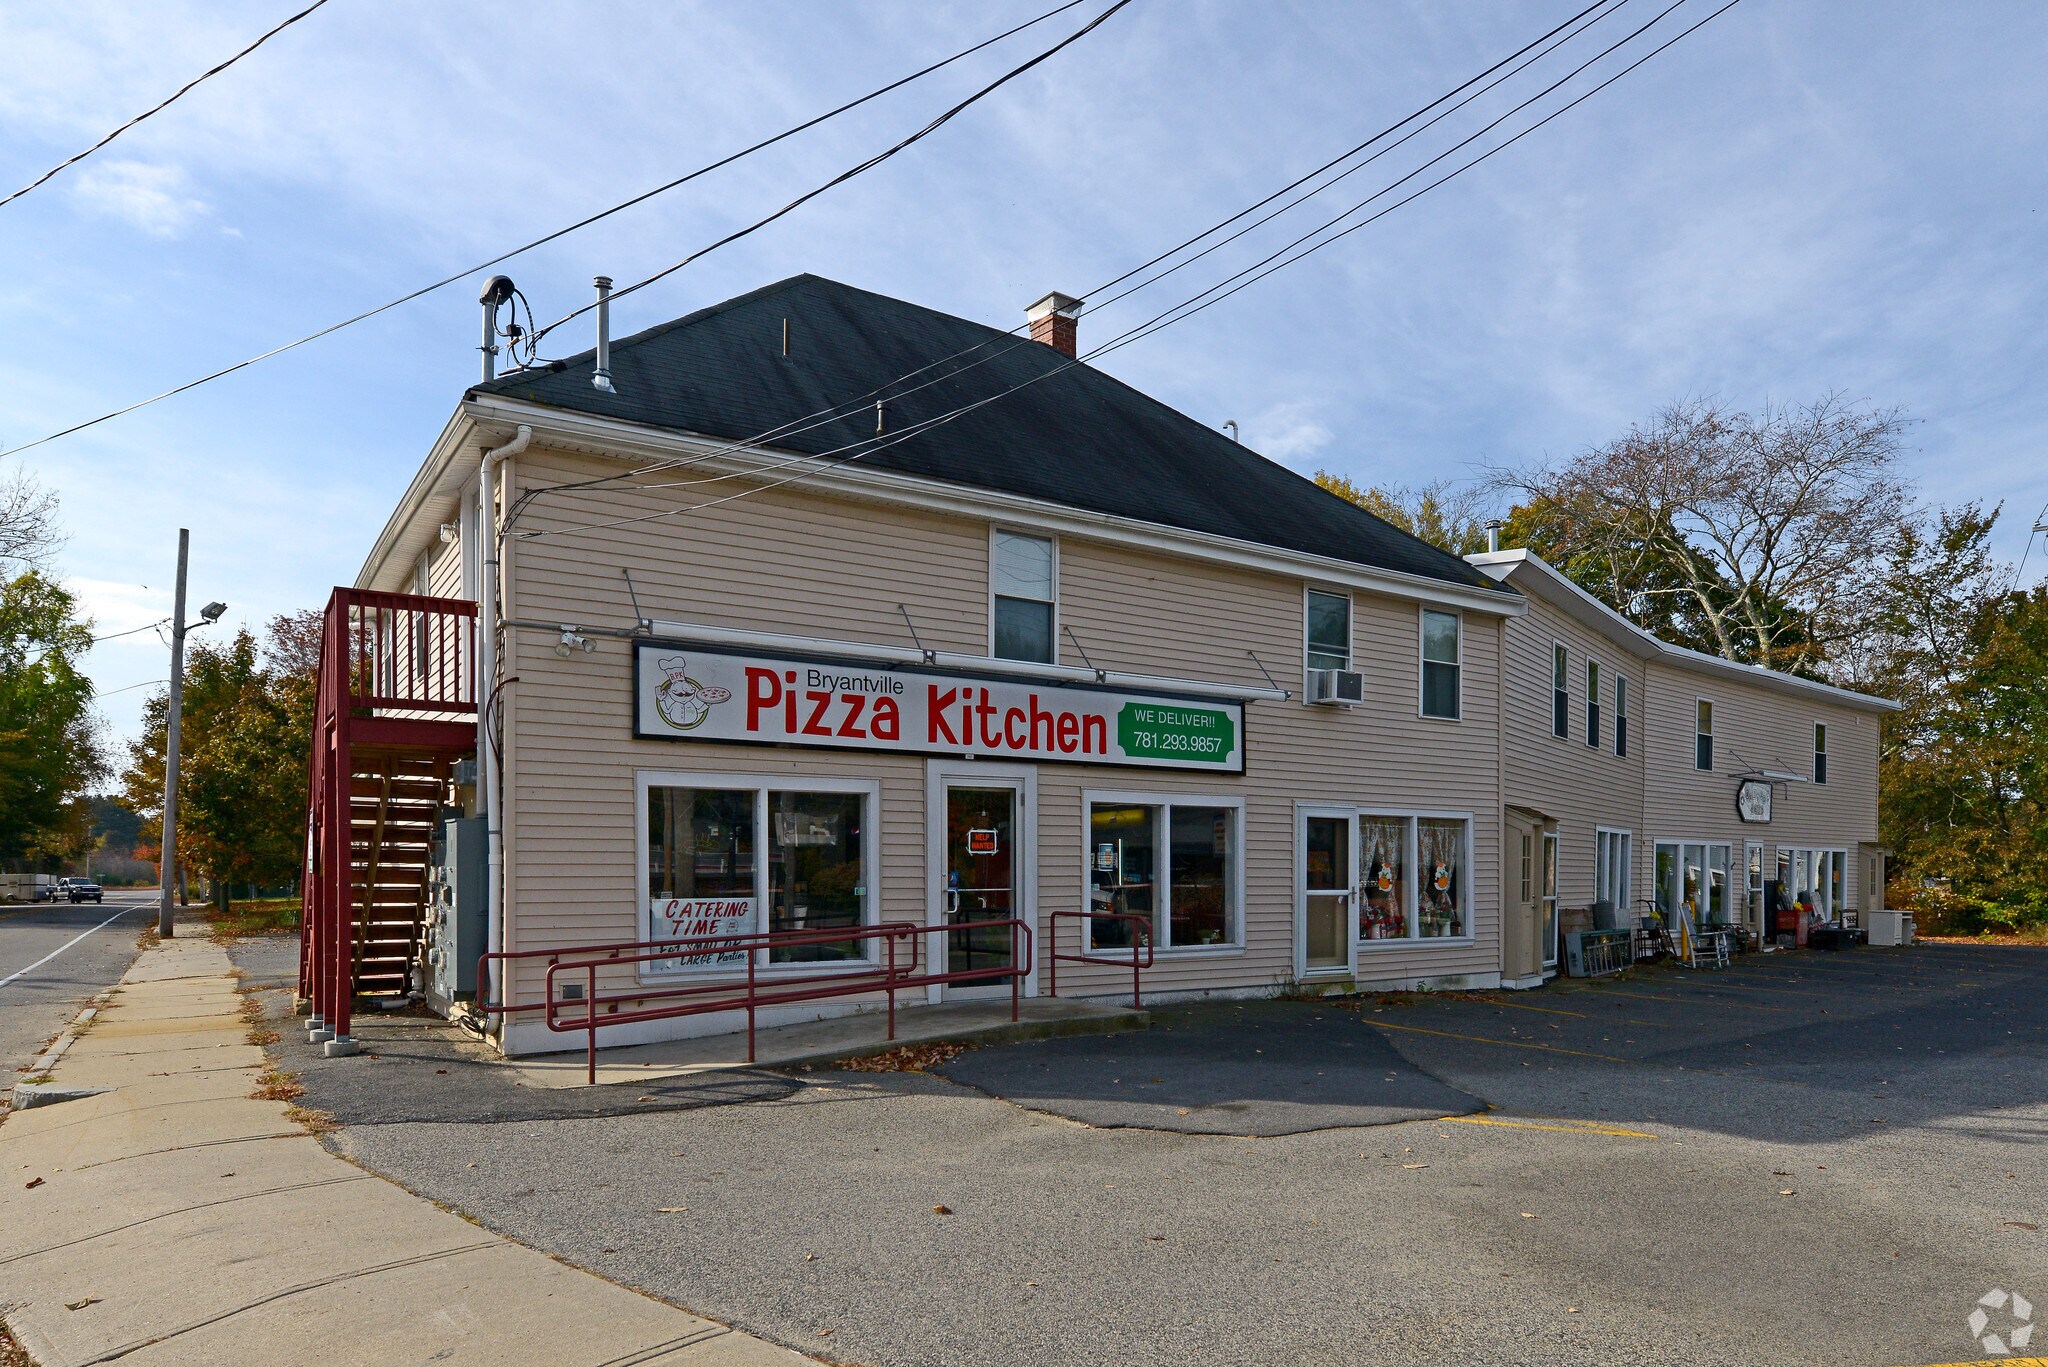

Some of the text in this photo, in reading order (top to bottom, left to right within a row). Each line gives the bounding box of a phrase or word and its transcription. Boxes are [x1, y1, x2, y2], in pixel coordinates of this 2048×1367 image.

[807, 668, 904, 695] Bryantville
[744, 666, 1107, 755] Pizza Kitchen
[1134, 708, 1215, 728] WE DELIVER!!
[1133, 731, 1222, 753] 781.293.9857
[971, 842, 994, 850] WANTED
[974, 833, 990, 841] HELP
[665, 899, 749, 919] CATERING
[672, 919, 721, 936] TIME
[680, 953, 714, 966] LARGE
